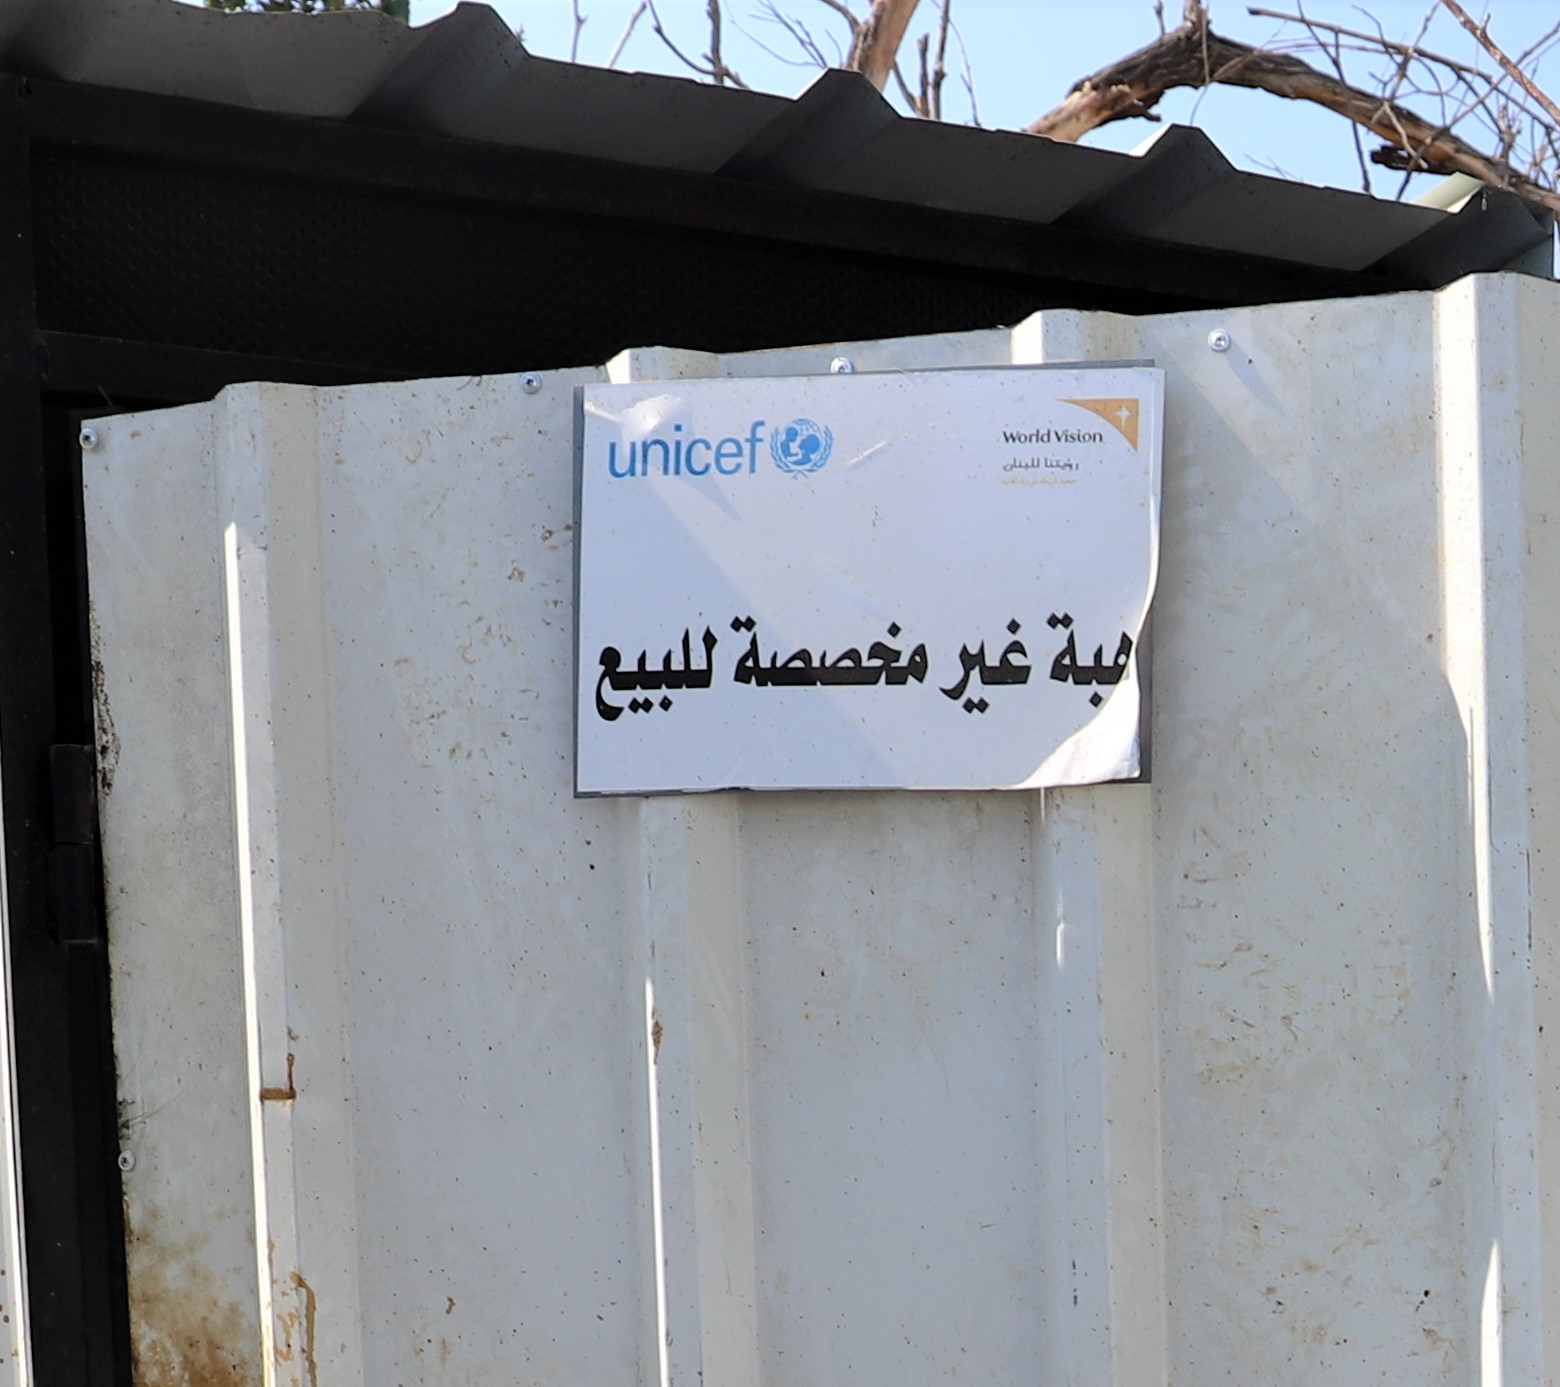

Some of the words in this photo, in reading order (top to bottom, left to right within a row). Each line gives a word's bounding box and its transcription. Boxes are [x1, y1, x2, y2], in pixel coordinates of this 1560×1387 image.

[608, 420, 766, 478] unicef
[1001, 428, 1051, 444] World
[1053, 428, 1103, 444] Vision
[595, 625, 718, 722] للبيع
[730, 615, 929, 687] مخصصة
[938, 617, 1032, 714] غير
